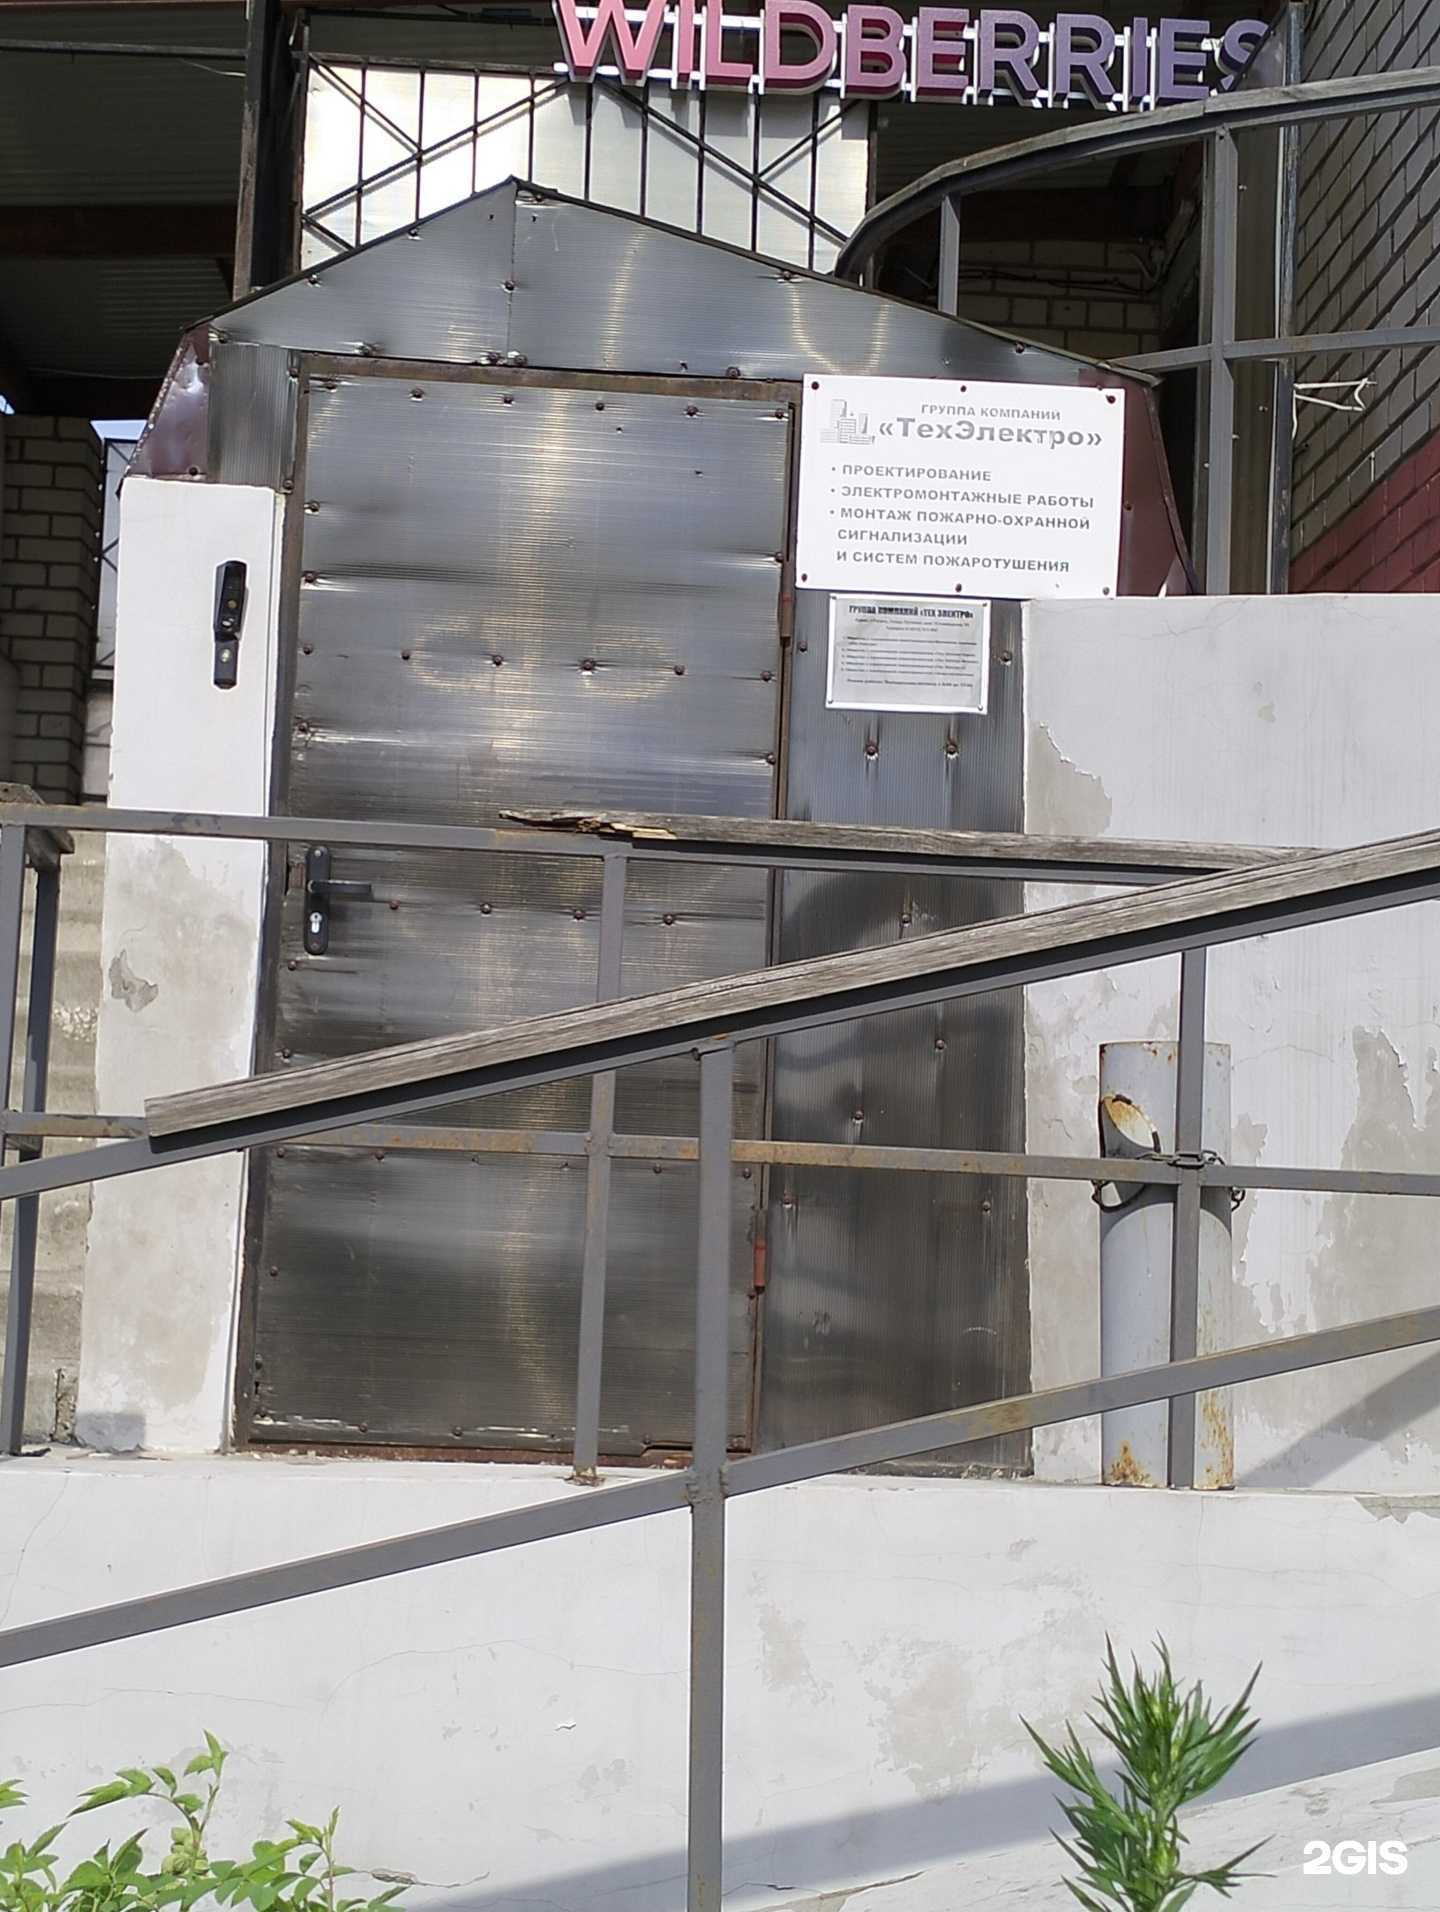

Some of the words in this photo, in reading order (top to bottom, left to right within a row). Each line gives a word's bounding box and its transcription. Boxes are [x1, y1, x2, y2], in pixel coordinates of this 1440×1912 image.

[921, 404, 976, 417] ГРУППА
[980, 407, 1061, 421] КОМПАНИЙ
[879, 417, 1102, 448] «ТехЭлектро»
[842, 464, 992, 482] ПРОЕКТИРОВАНИЕ
[841, 486, 1022, 505] ЭЛЕКТРОМОНТАЖНЫЕ
[1027, 495, 1094, 509] РАБОТЫ
[840, 507, 912, 521] МОНТАЖ
[917, 510, 1090, 529] ПОЖАРНО-ОХРАННОЙ
[837, 529, 968, 546] СИГНАЛИЗАЦИИ
[837, 551, 847, 562] И
[852, 551, 918, 566] СИСТЕМ
[923, 555, 1070, 573] ПОЖАРОТУШЕНИЯ
